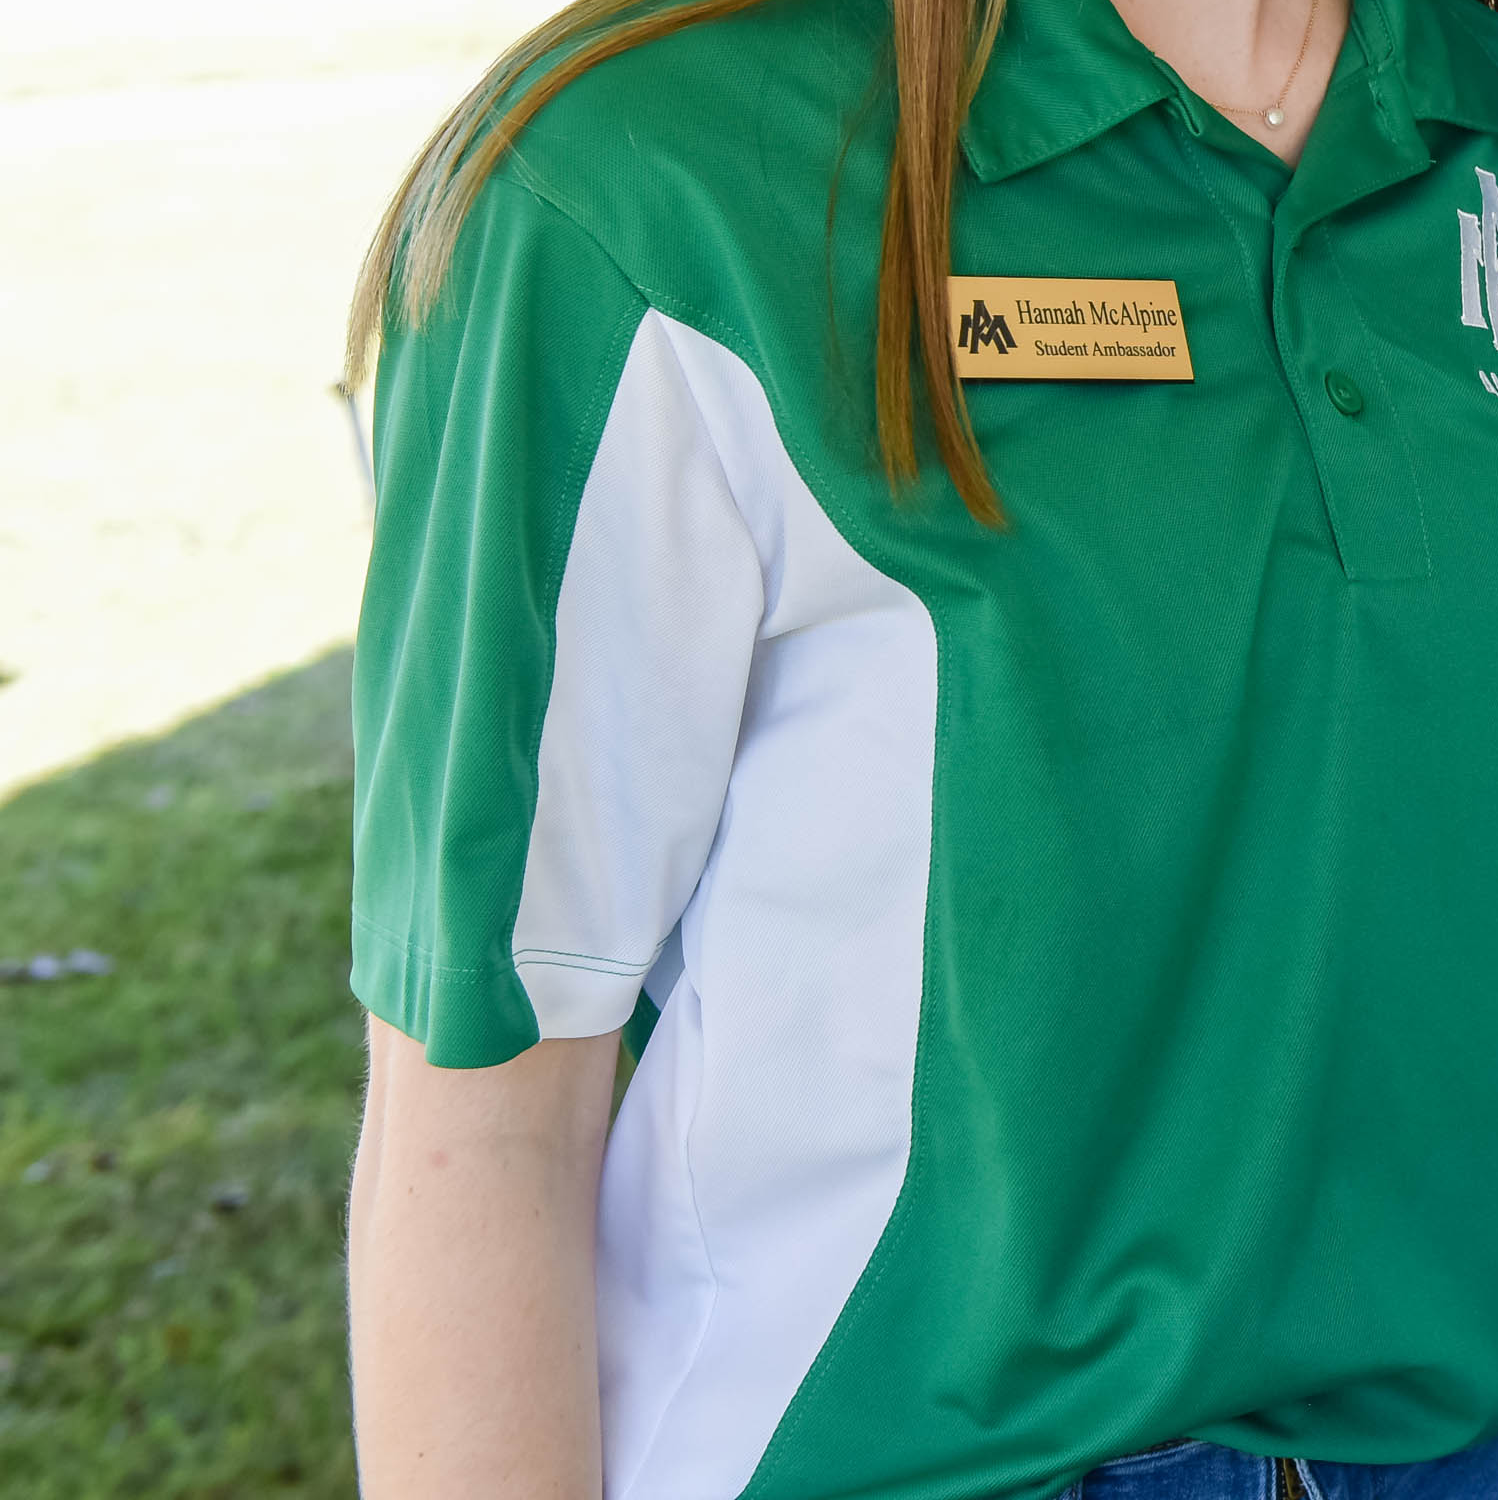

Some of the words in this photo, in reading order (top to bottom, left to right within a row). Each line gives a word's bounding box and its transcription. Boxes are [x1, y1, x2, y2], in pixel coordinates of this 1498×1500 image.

[1016, 300, 1086, 325] Hannah
[1088, 301, 1178, 333] McAlpine
[1034, 340, 1089, 357] Student
[1092, 341, 1177, 357] Ambassador
